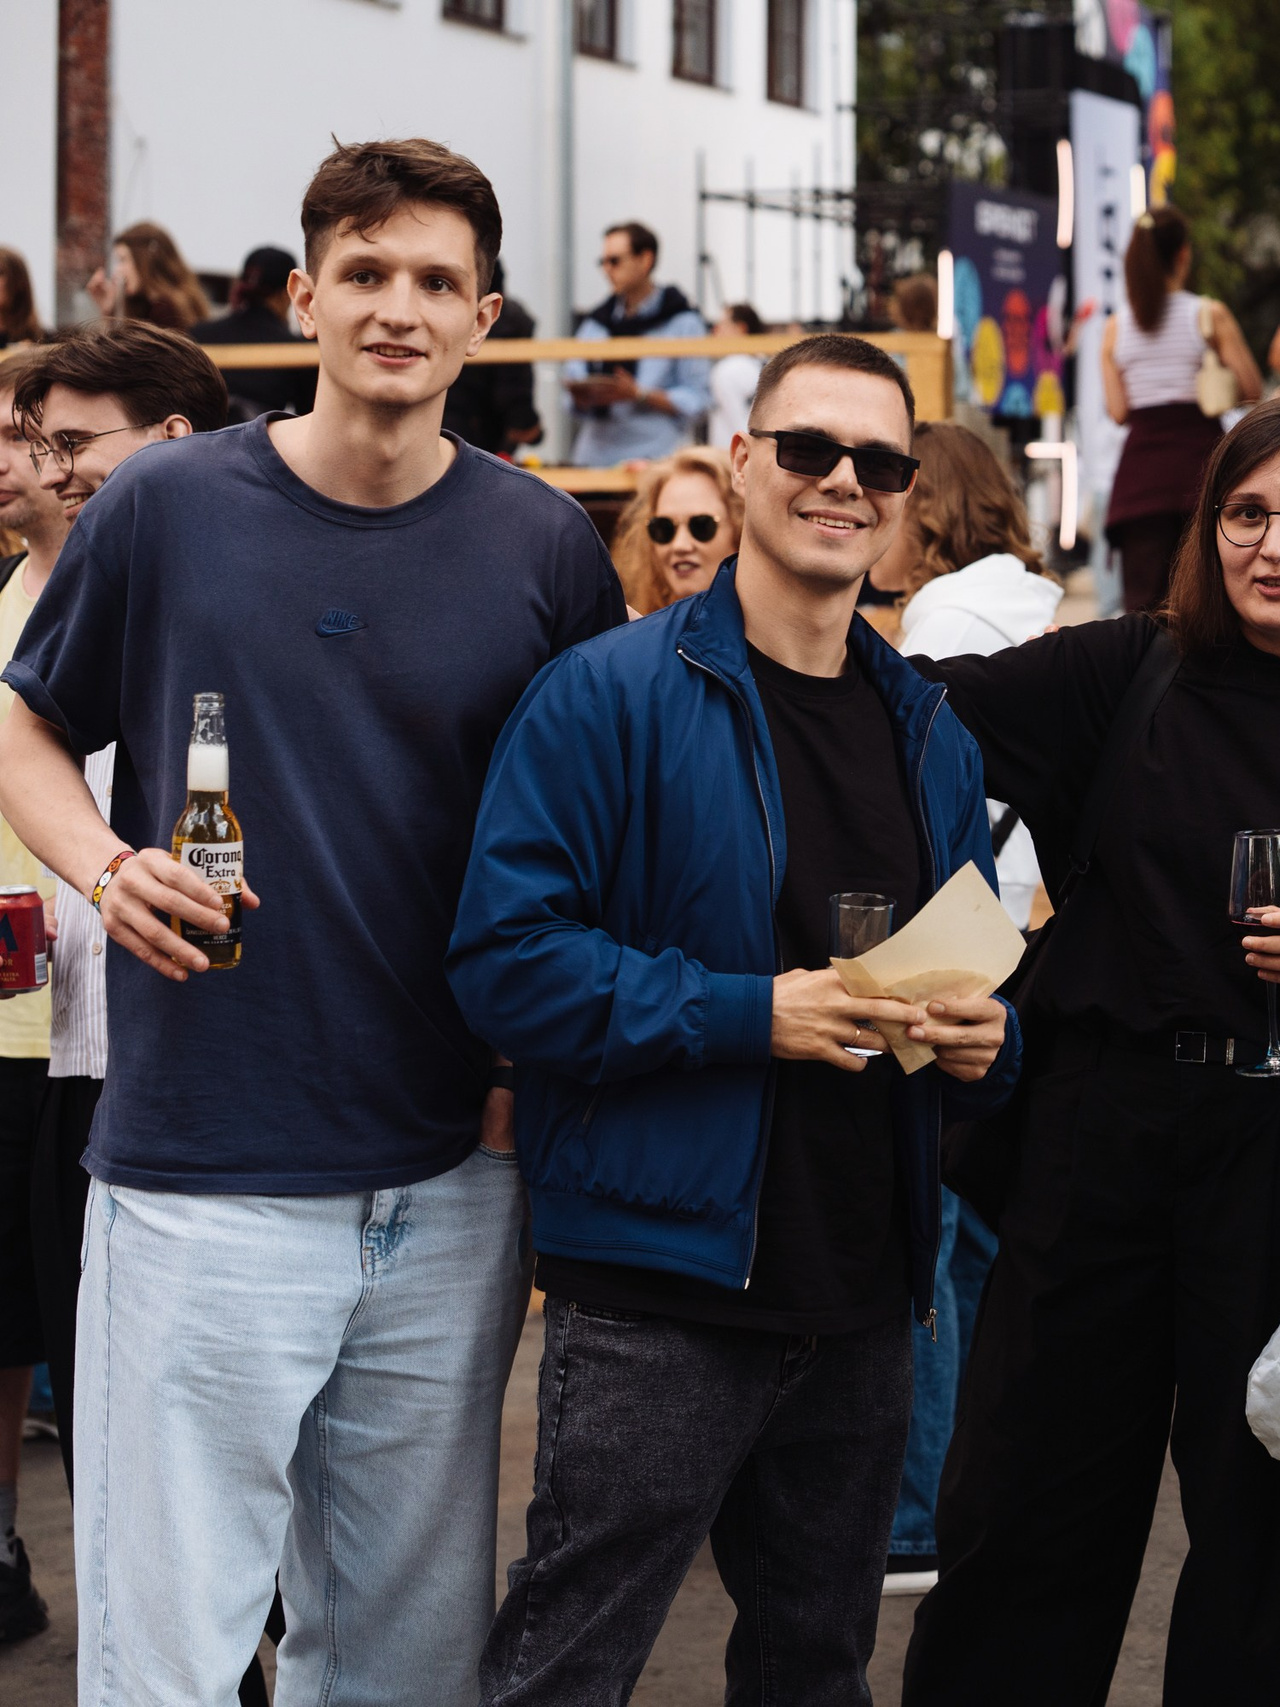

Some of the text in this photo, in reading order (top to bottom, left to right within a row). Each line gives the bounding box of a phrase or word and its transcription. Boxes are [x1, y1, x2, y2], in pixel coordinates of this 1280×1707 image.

[327, 609, 359, 629] NIKE
[188, 847, 242, 870] Corona
[206, 865, 236, 878] Extra
